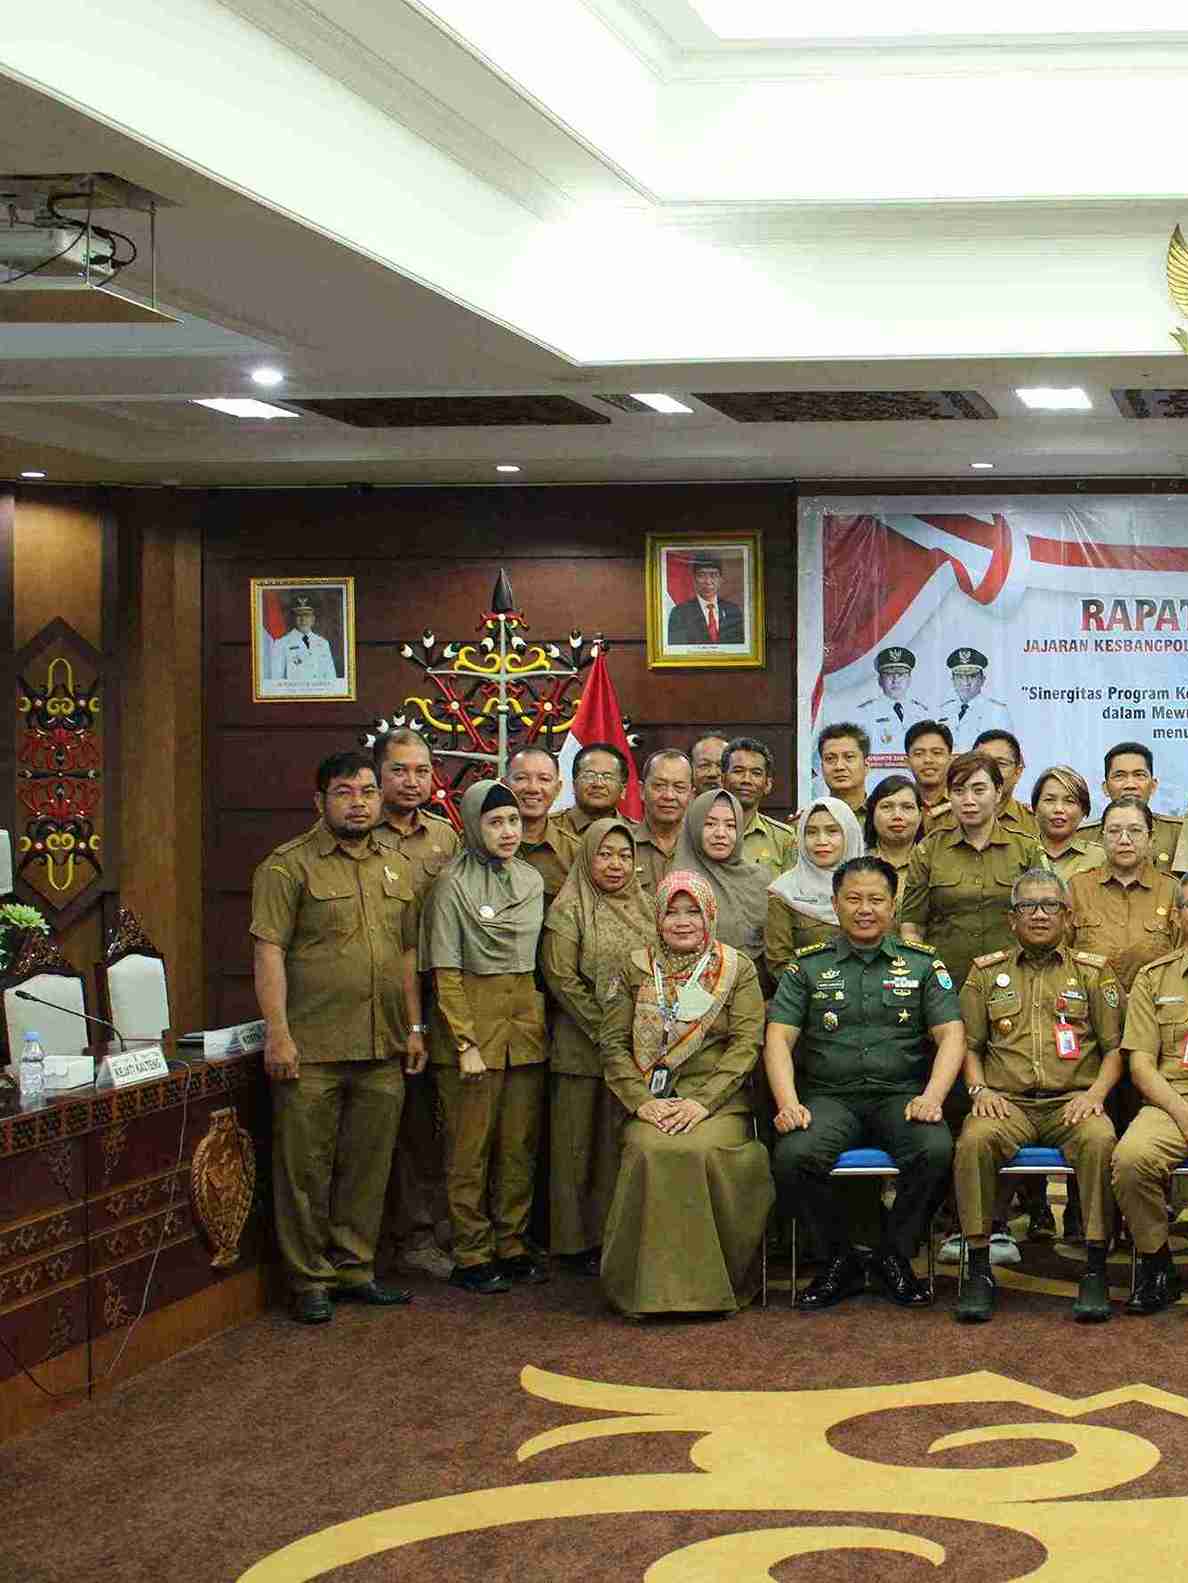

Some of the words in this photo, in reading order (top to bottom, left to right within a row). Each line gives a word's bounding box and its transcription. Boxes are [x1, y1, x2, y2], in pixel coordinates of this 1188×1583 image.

[1023, 639, 1089, 653] JAJARAN
[1107, 686, 1170, 704] Program
[1101, 705, 1146, 720] dalam
